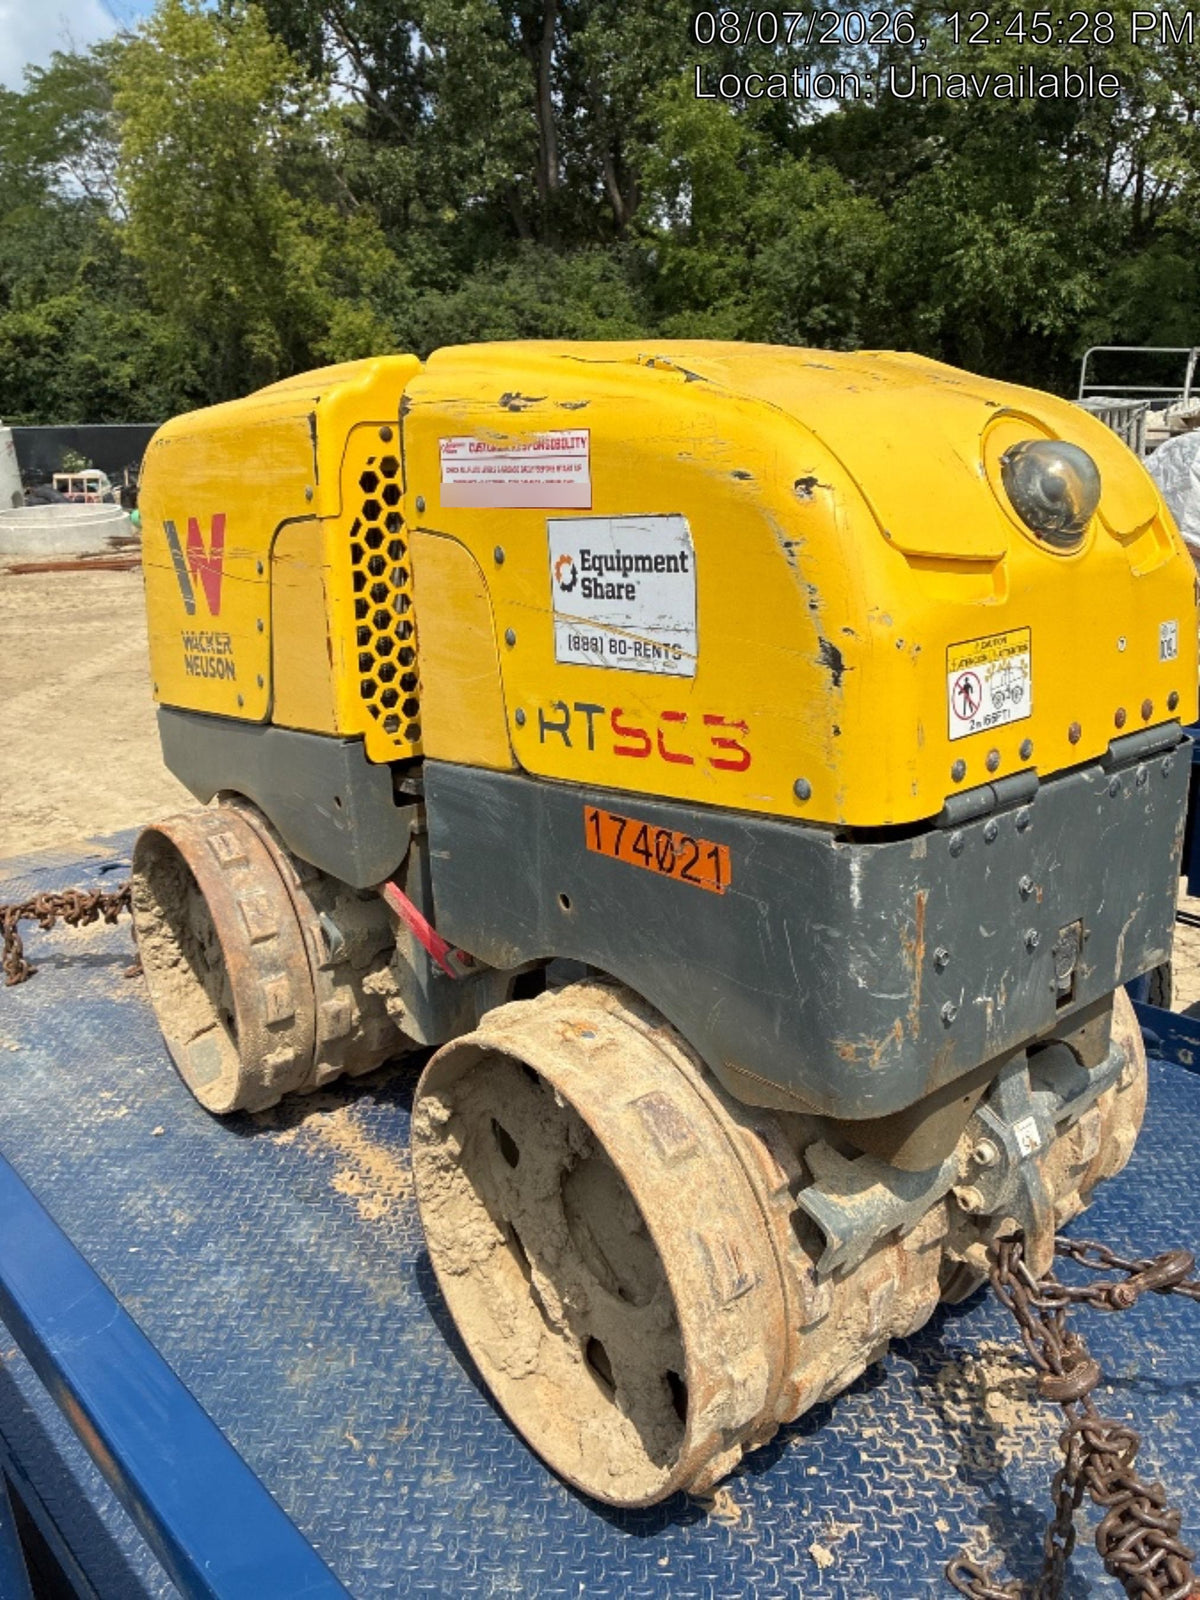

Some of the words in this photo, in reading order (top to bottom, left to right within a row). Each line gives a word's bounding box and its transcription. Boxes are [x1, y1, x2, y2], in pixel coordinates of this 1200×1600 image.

[579, 549, 688, 577] Equipment
[581, 577, 636, 600] Share
[181, 631, 233, 655] WACKER
[184, 654, 237, 681] NEUSON
[590, 811, 721, 889] 174021
